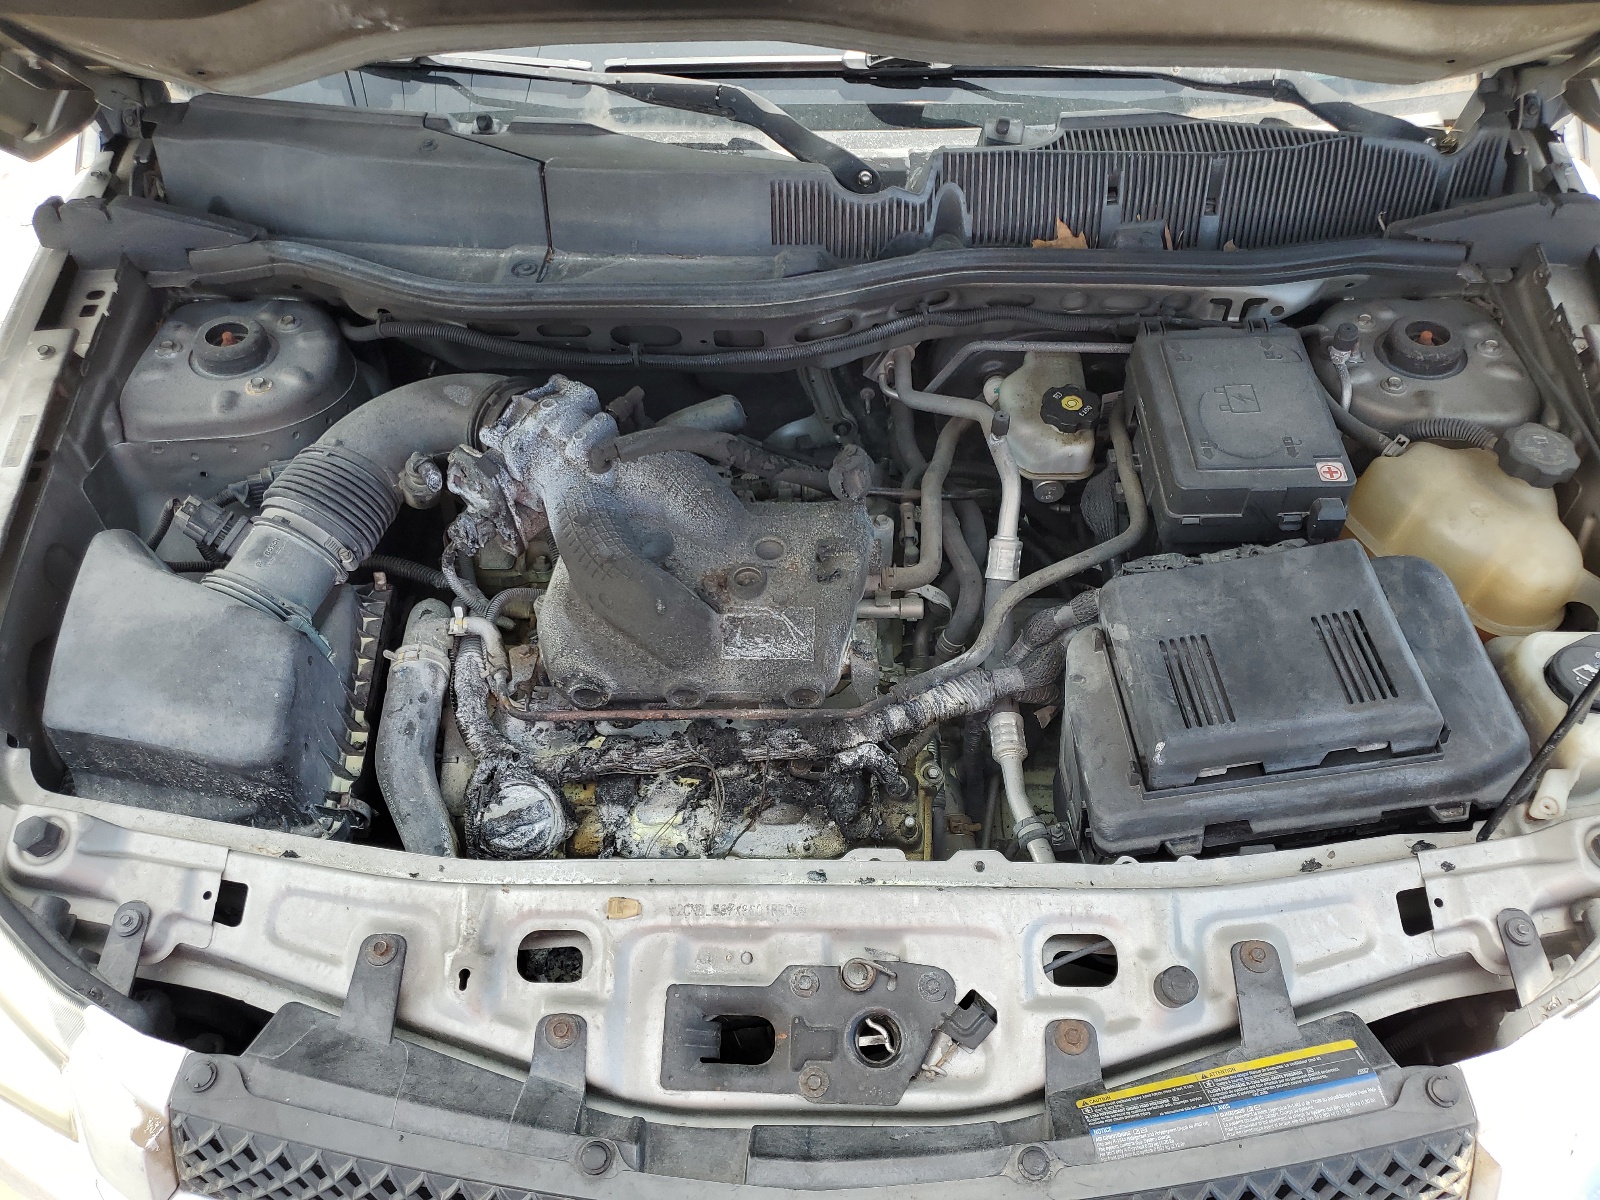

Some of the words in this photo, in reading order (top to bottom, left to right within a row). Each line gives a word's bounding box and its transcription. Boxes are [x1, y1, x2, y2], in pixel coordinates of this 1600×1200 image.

[1208, 1066, 1237, 1078] ATTENTION
[1088, 1095, 1112, 1105] CAUTION
[1092, 1126, 1112, 1136] NOTICE
